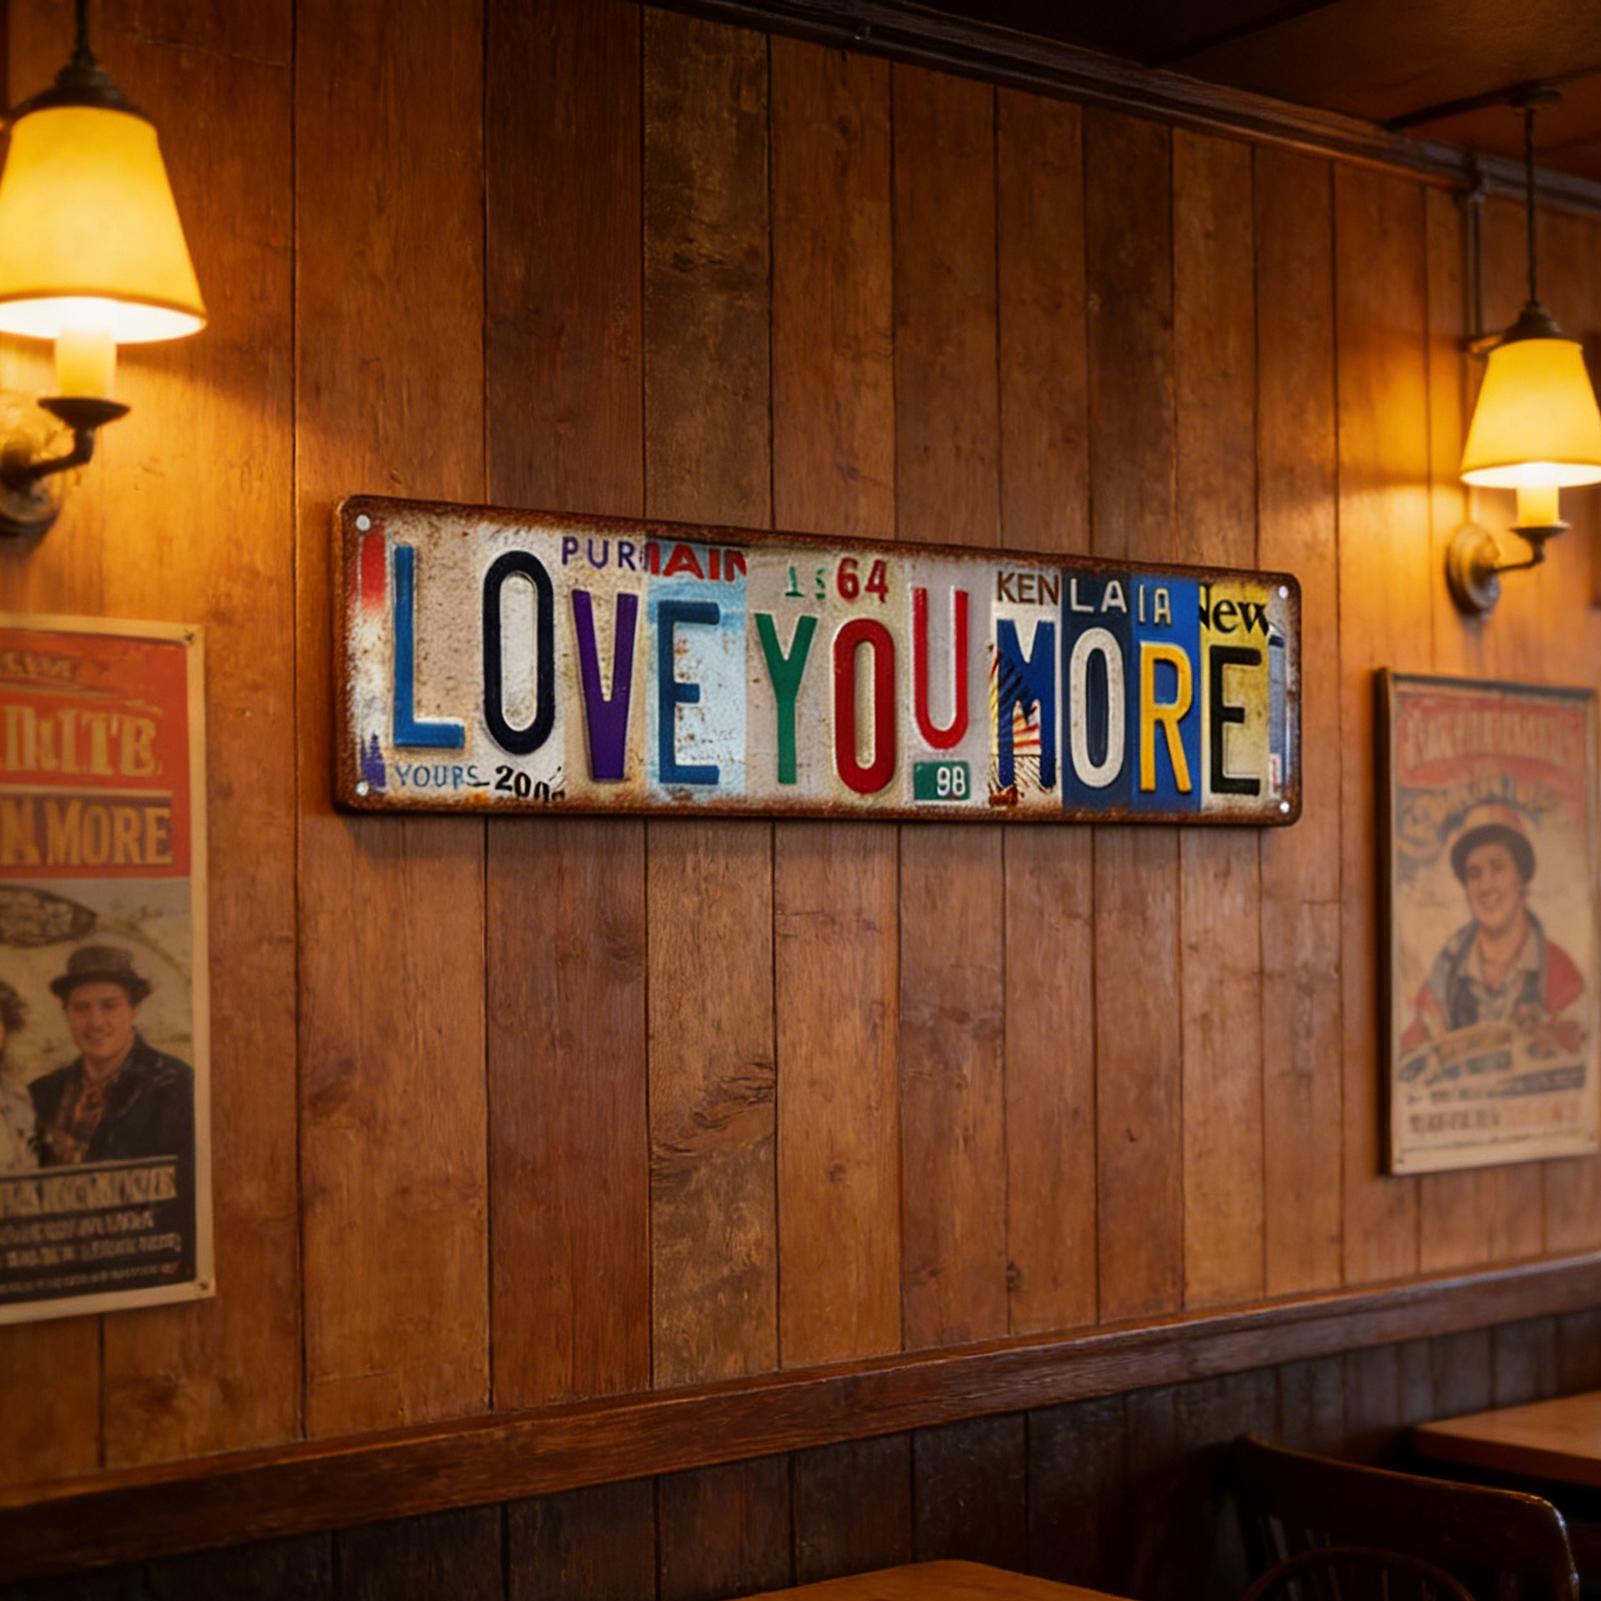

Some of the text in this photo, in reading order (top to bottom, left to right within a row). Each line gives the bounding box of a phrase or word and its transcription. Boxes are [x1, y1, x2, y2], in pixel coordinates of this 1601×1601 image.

[837, 557, 889, 603] 64
[997, 571, 1060, 605] KEN
[1070, 578, 1127, 613] LA
[393, 544, 1262, 797] LOVE YOU MORE
[936, 766, 967, 797] 98
